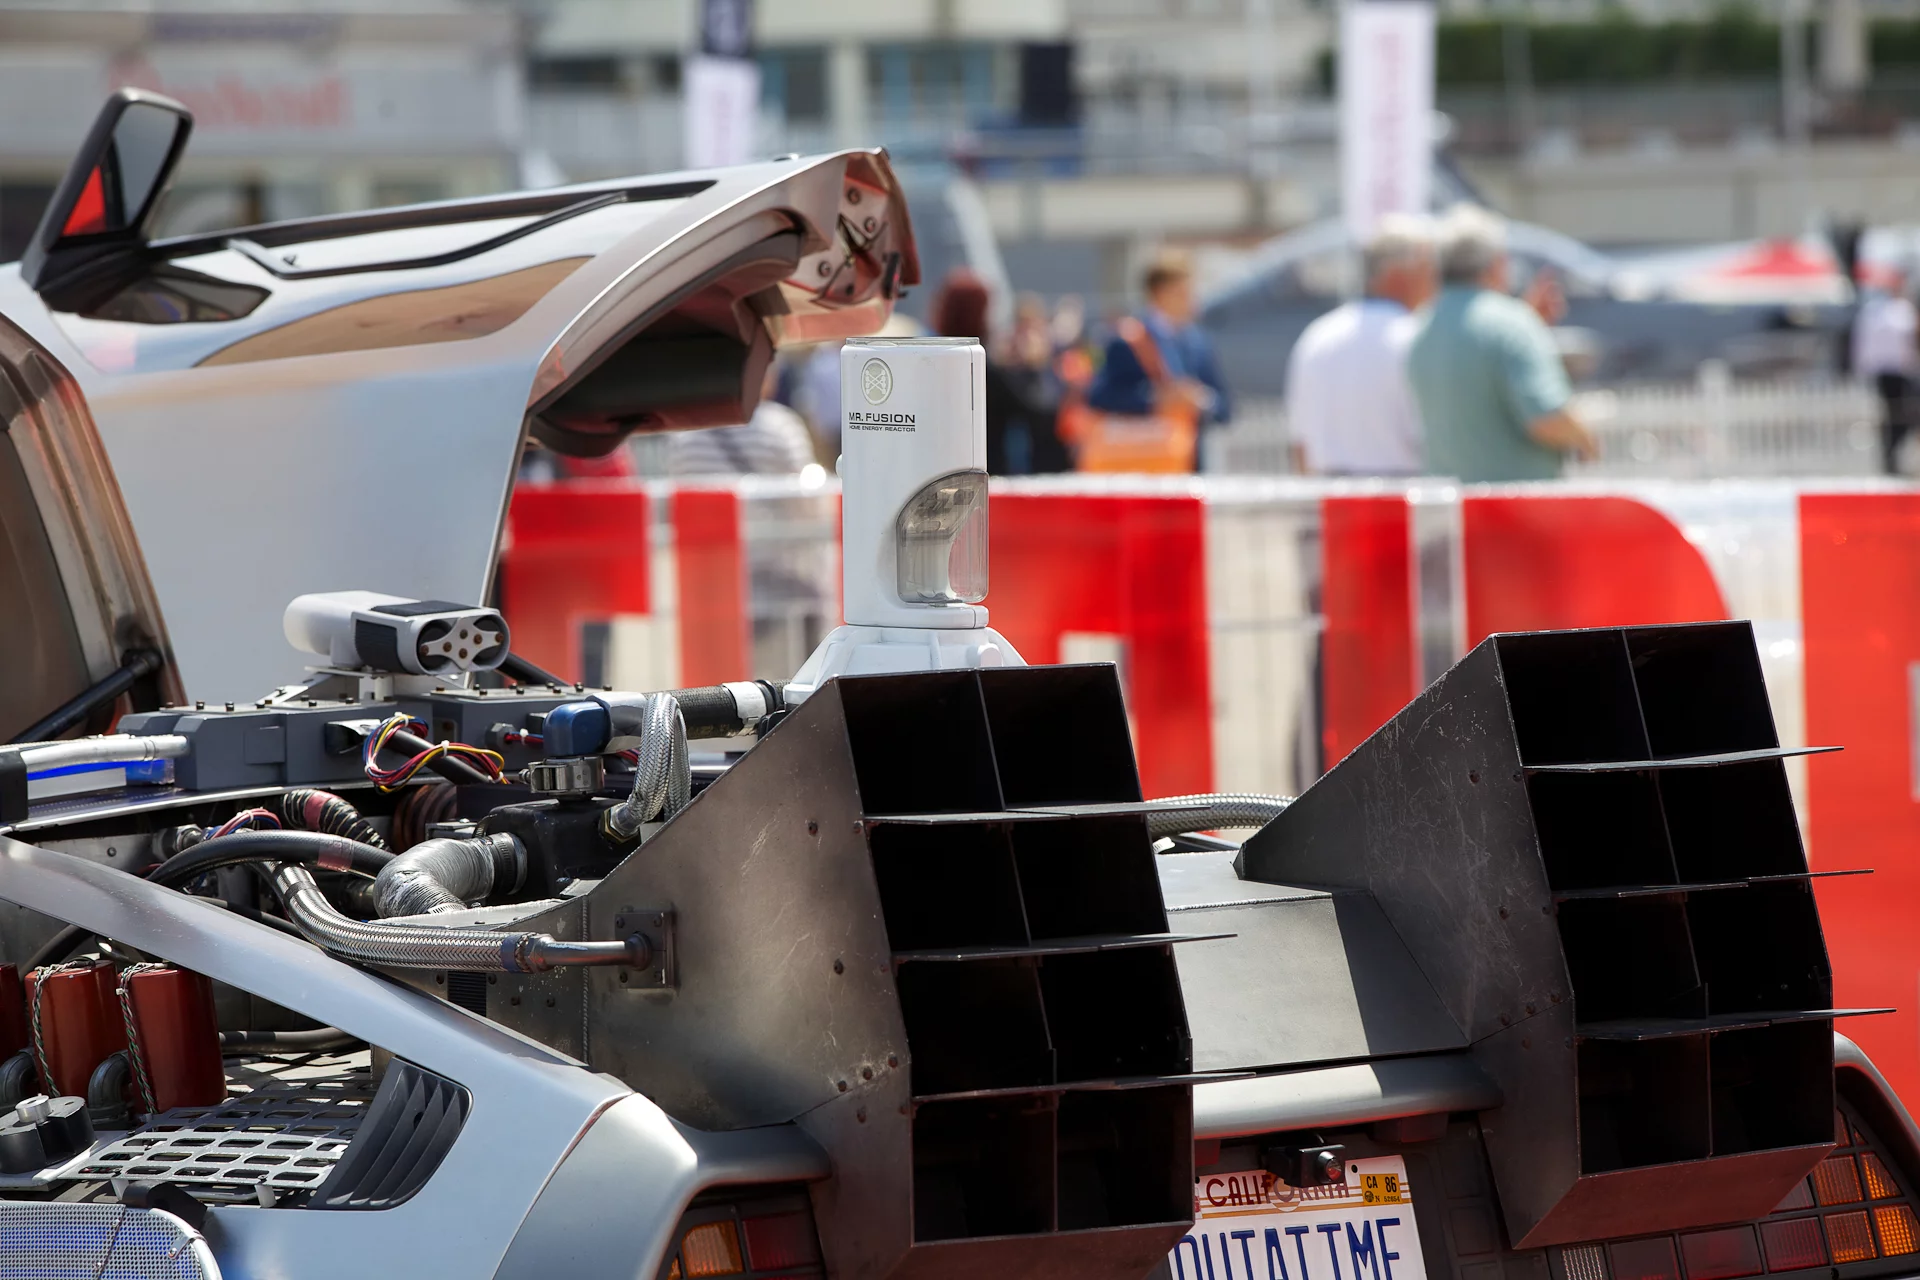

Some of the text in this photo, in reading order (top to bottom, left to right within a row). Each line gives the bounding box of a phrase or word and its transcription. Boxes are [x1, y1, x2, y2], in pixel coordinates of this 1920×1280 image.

[849, 412, 915, 423] MR. FUSION
[1366, 1176, 1397, 1193] CA 86
